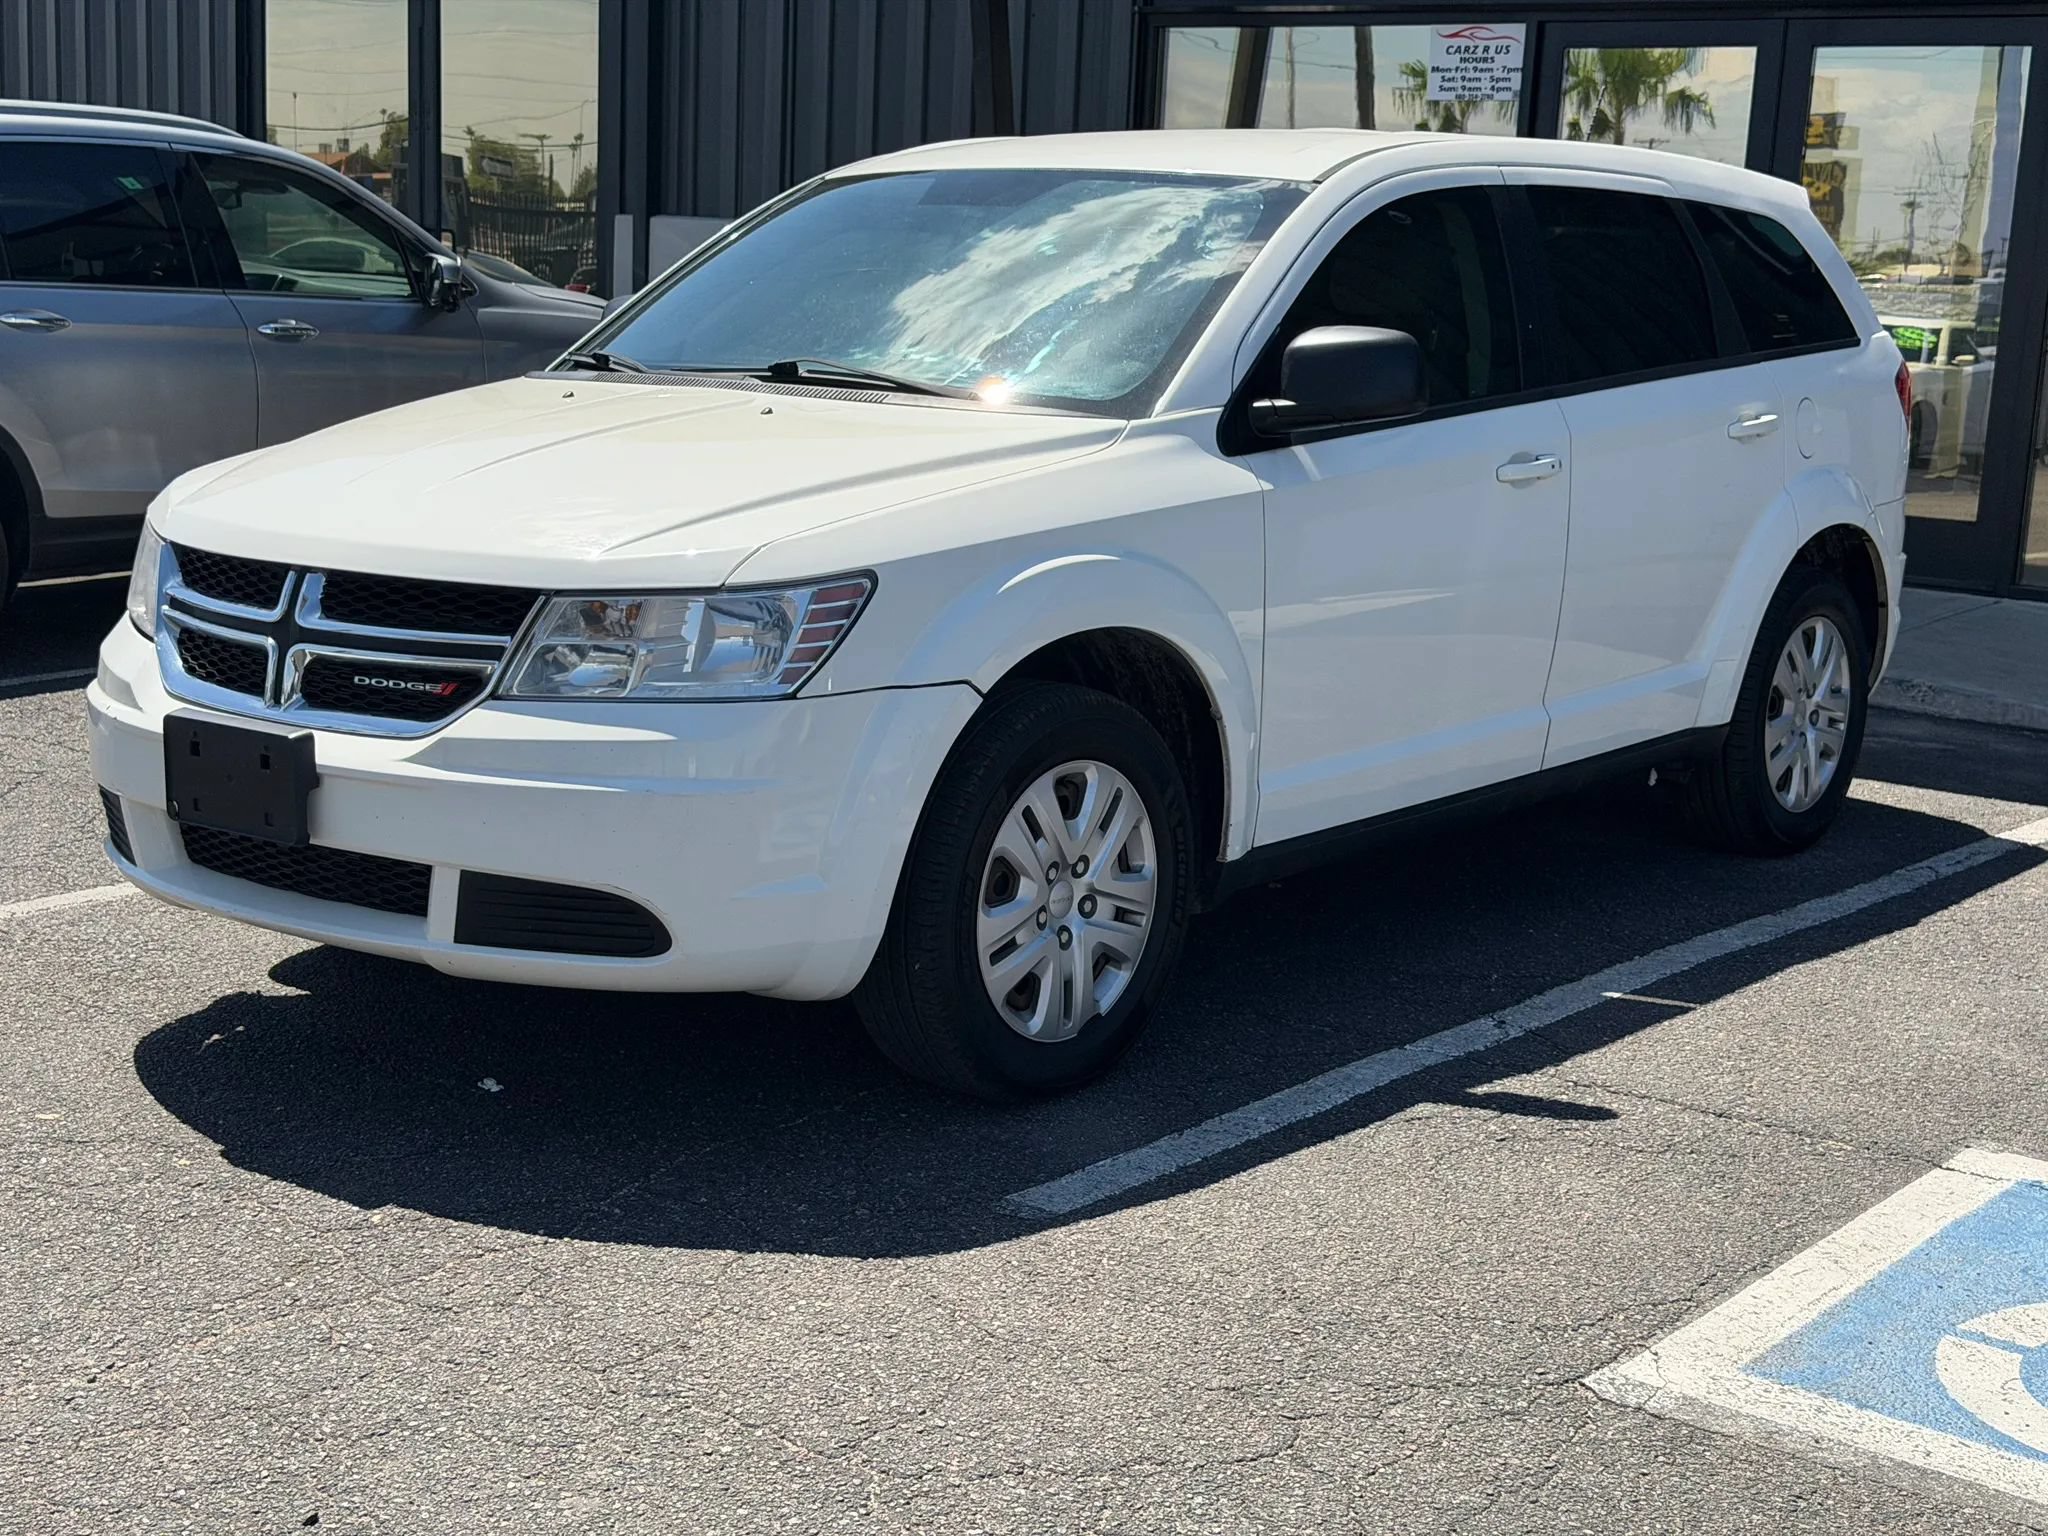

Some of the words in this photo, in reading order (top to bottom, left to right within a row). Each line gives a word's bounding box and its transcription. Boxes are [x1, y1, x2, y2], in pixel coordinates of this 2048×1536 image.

[1445, 45, 1479, 55] CARZ
[1481, 45, 1490, 55] R
[1494, 45, 1511, 55] US
[1460, 56, 1495, 64] HOURS
[1472, 66, 1494, 74] 9am
[1501, 65, 1523, 75] 7pm
[1440, 75, 1458, 83] Sat:
[1460, 75, 1482, 83] 9am
[1489, 75, 1511, 84] 5pm
[1438, 85, 1458, 93] Sun:
[1460, 85, 1482, 93] 9am
[1489, 85, 1512, 94] 4pm
[353, 676, 443, 693] DODGE
